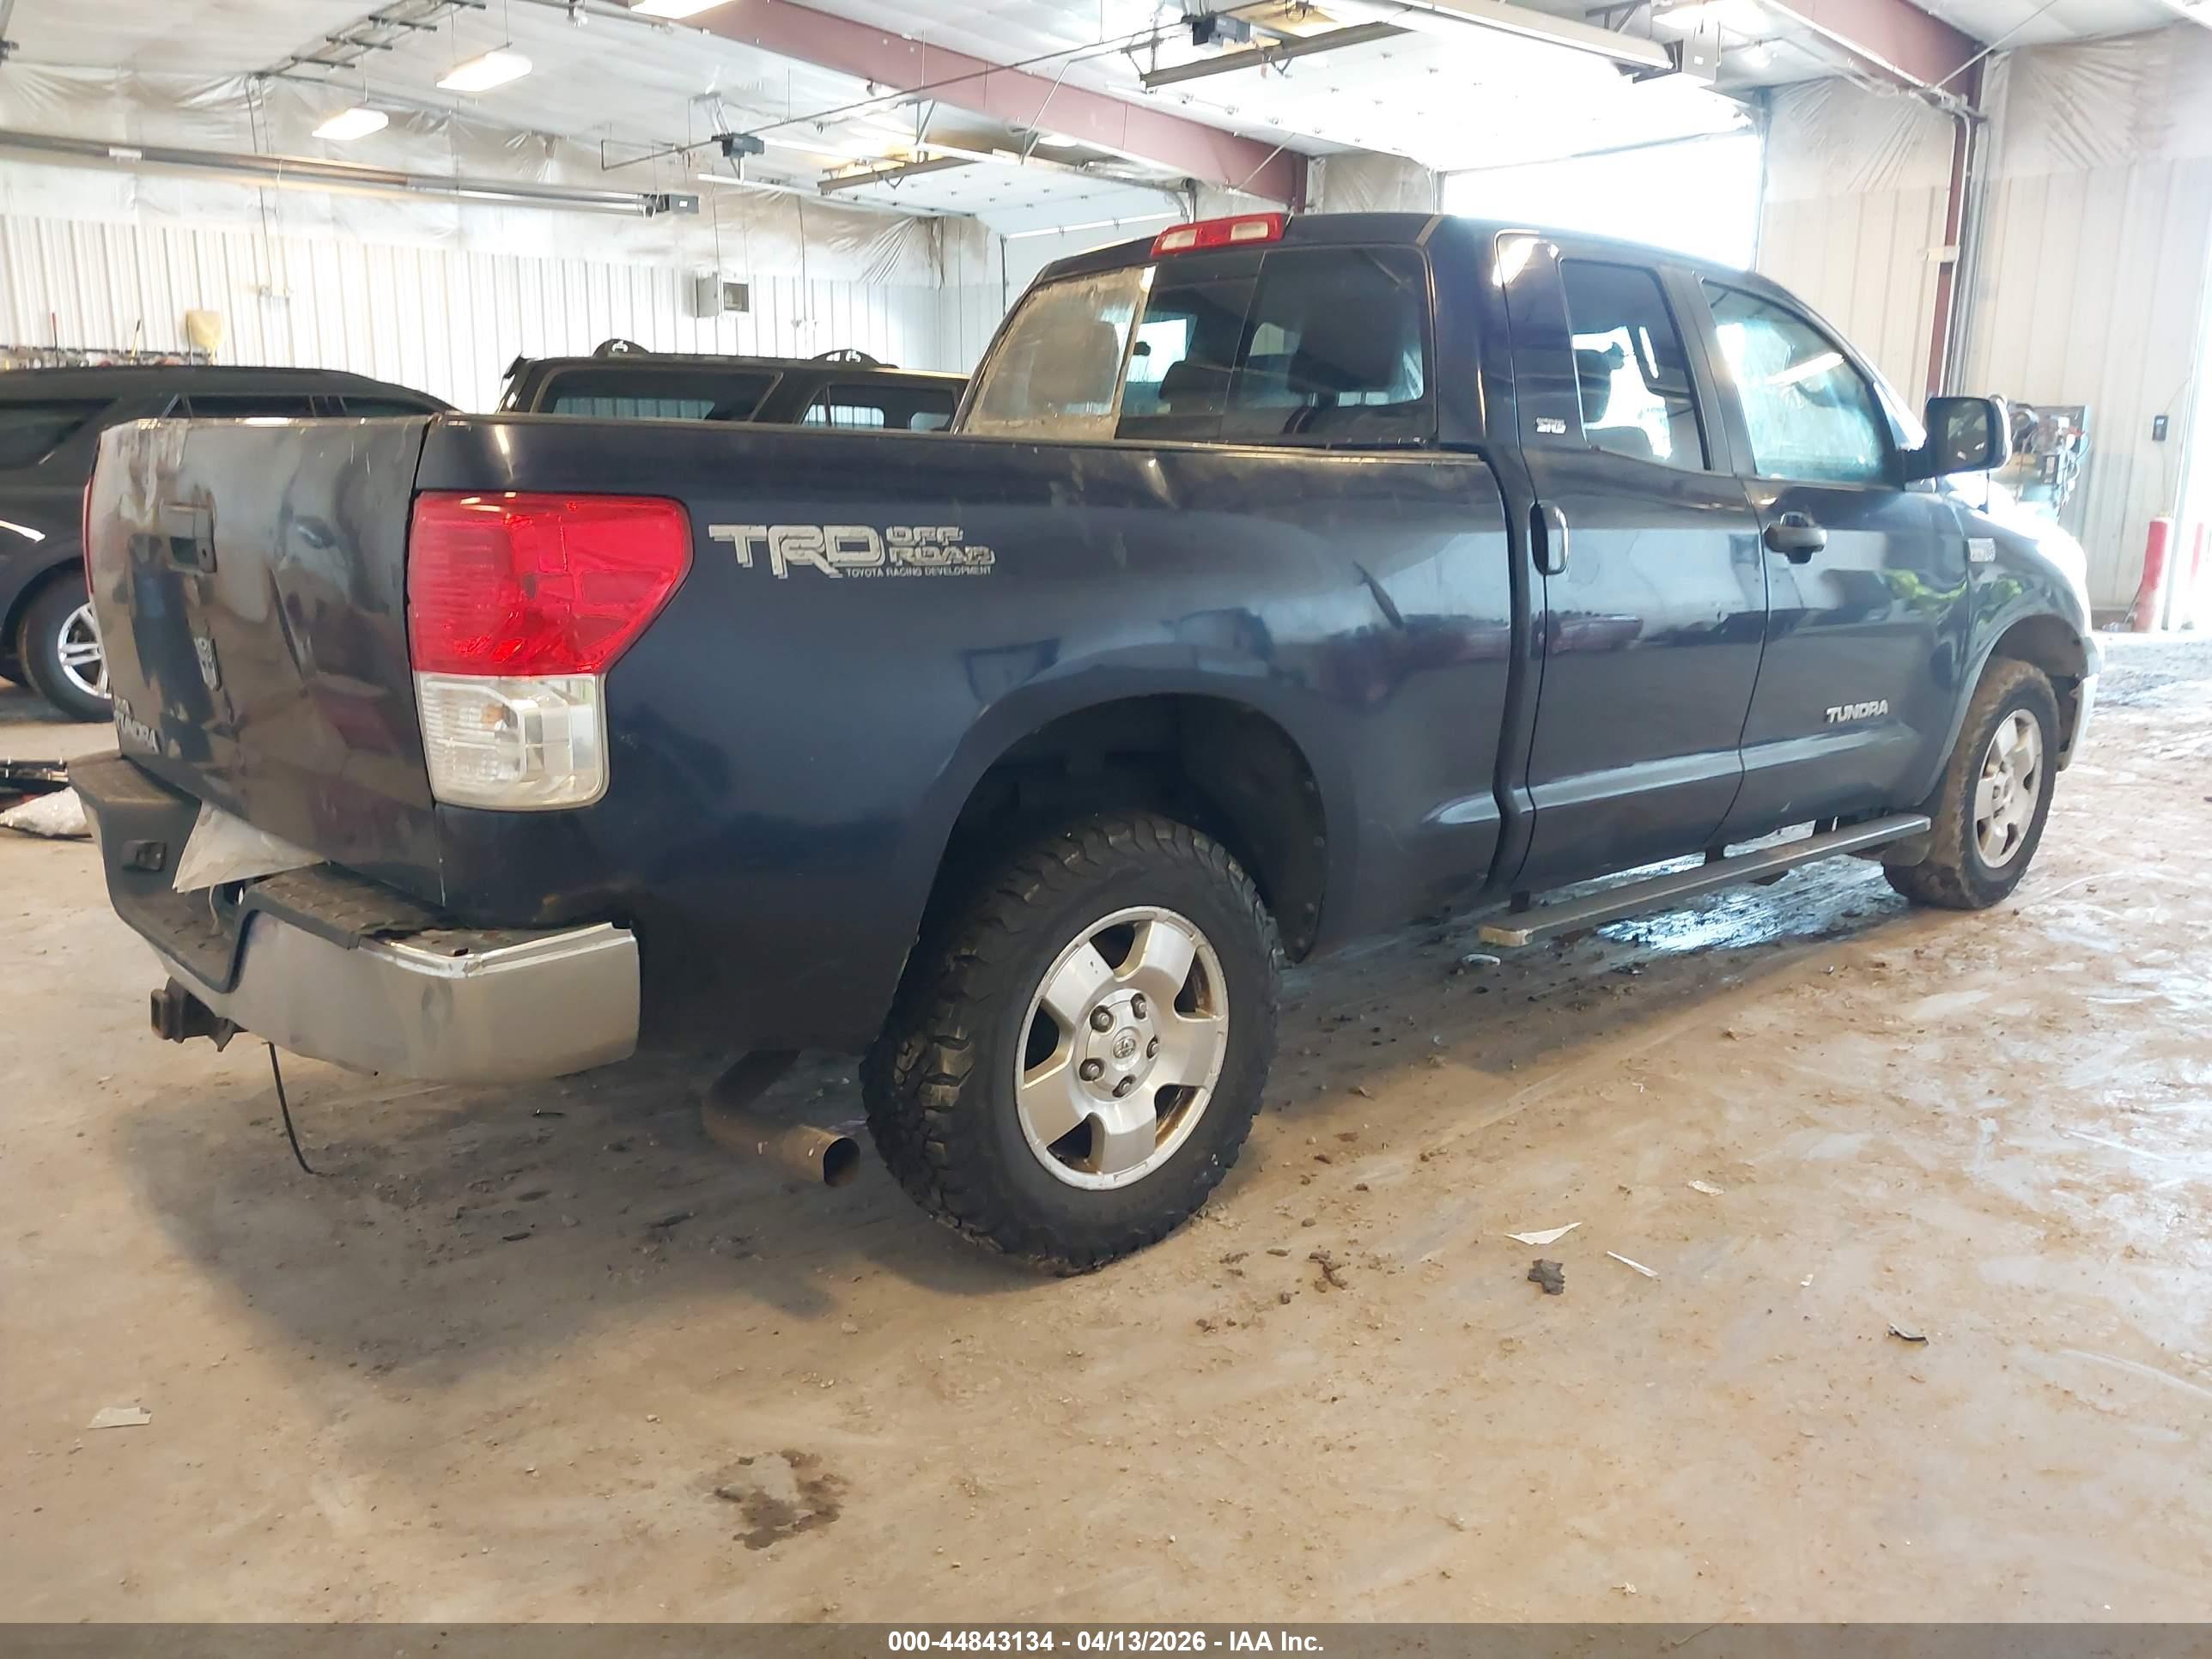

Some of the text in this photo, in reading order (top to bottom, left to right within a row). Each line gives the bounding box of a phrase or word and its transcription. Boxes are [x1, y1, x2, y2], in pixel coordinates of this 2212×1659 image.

[886, 526, 963, 547] OFF
[708, 524, 886, 579] TRD
[888, 545, 996, 567] ROAD
[847, 565, 992, 578] TOYOTA RACING DEVELOPMENT
[1826, 699, 1888, 723] TUNDRA
